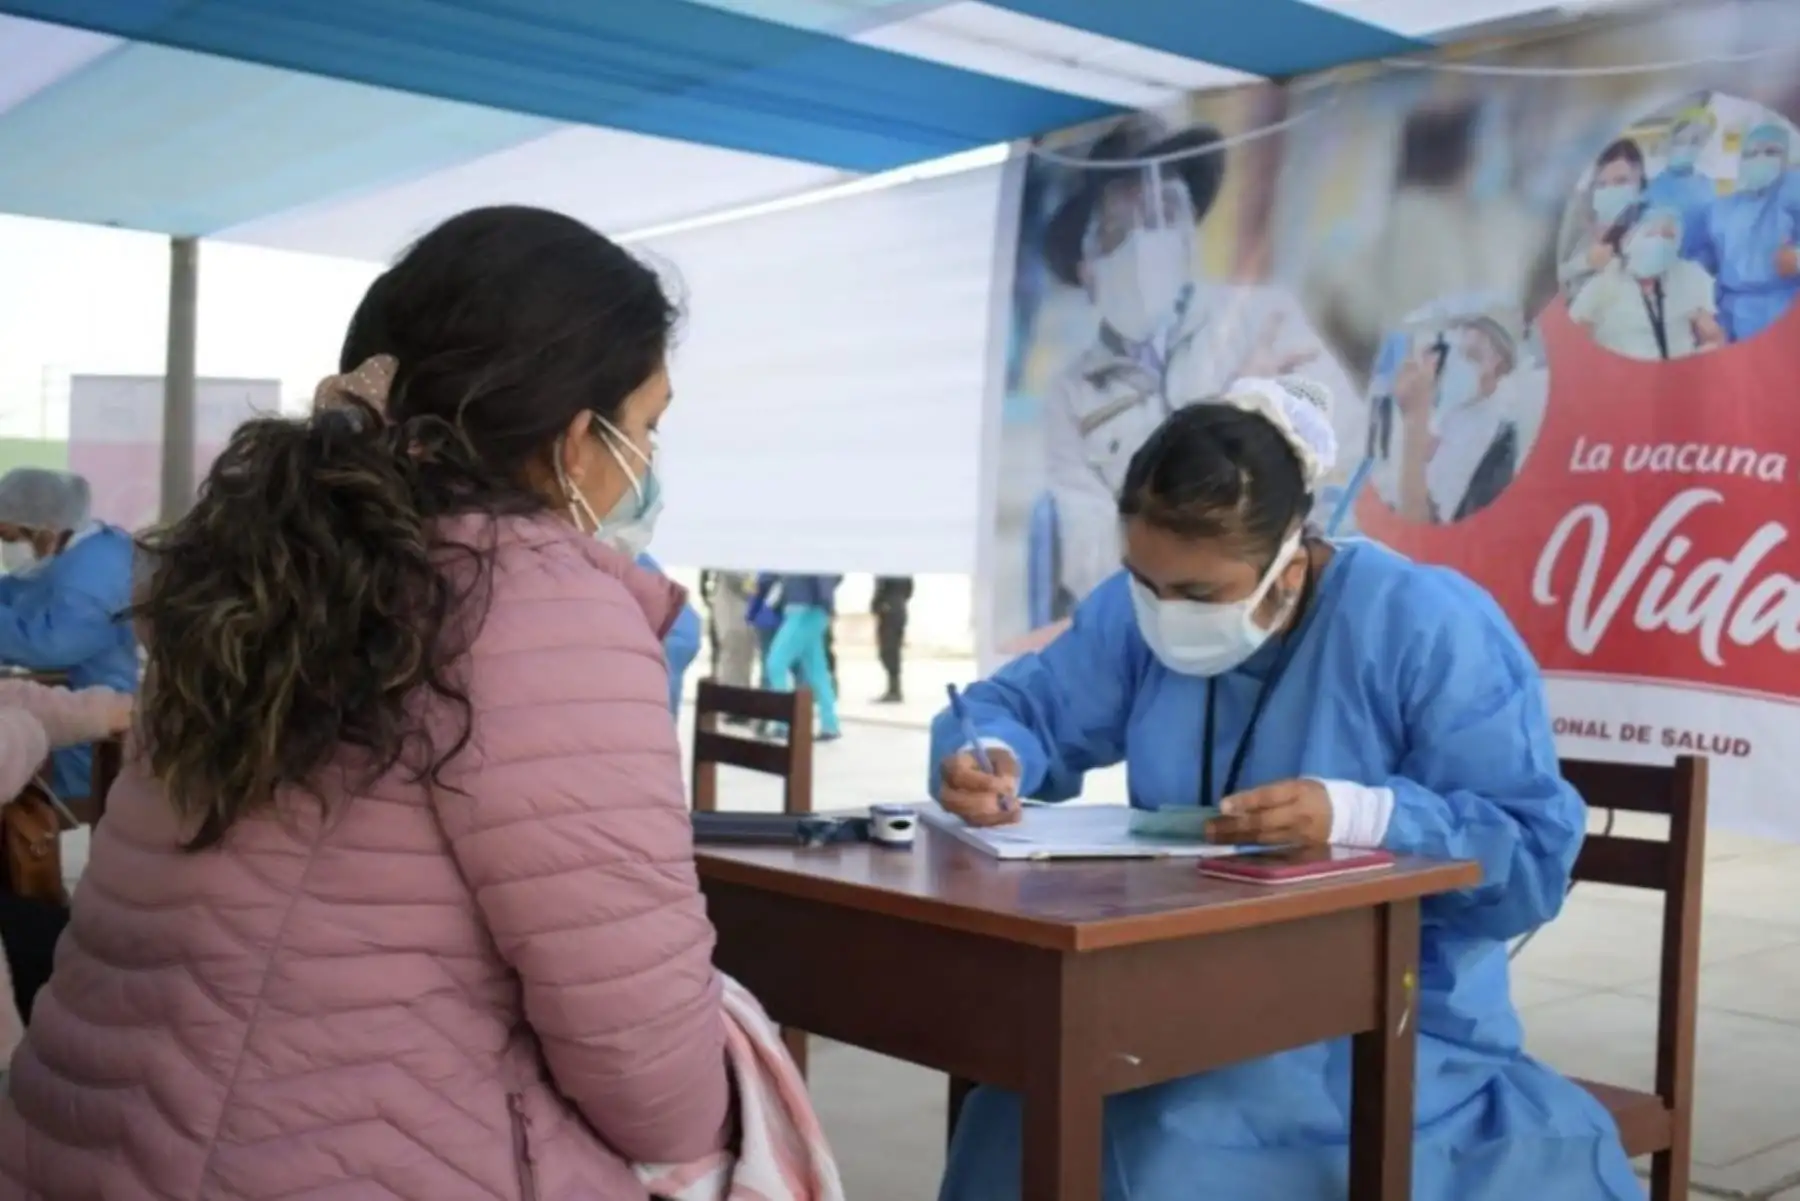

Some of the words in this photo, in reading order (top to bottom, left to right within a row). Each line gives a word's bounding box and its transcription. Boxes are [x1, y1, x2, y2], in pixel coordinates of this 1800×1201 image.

[1569, 436, 1613, 472] La
[1622, 443, 1788, 482] vacuna
[1532, 487, 1800, 668] Vida
[1619, 723, 1653, 743] DE
[1660, 728, 1752, 758] SALUD
